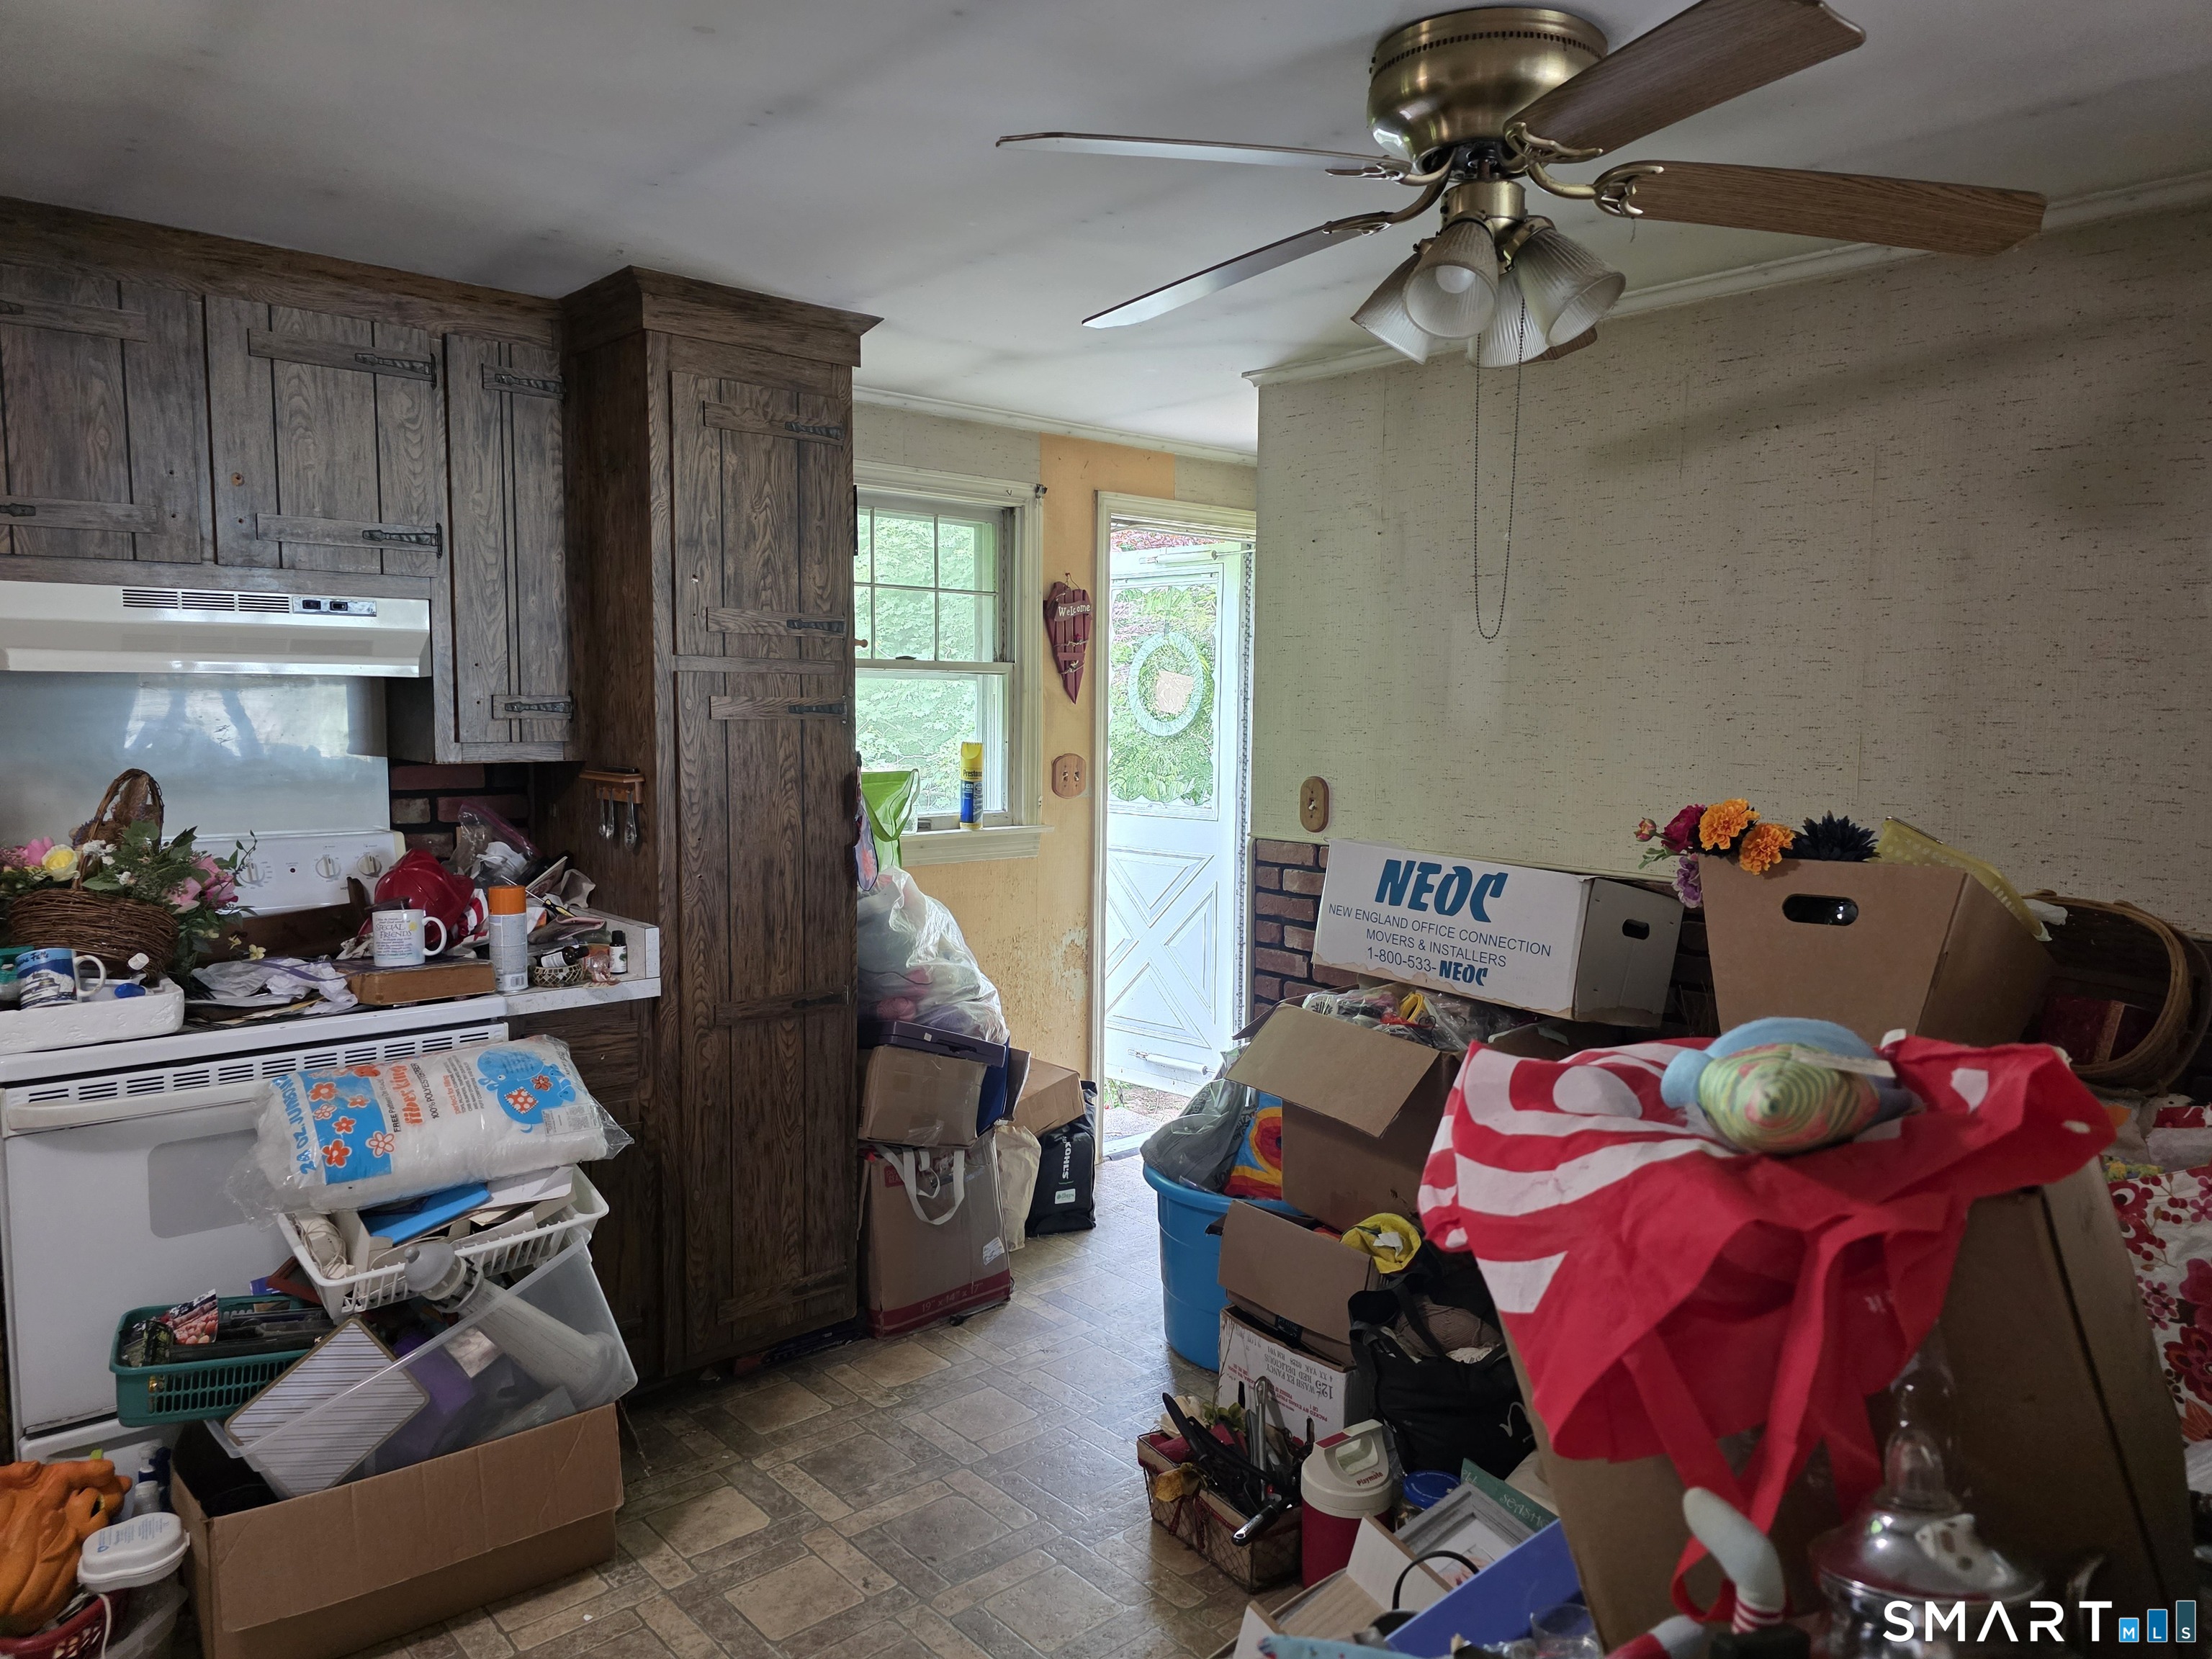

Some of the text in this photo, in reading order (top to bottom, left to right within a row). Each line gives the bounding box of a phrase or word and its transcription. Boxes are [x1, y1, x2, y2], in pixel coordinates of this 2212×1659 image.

[1058, 605, 1091, 617] Welcome
[1374, 859, 1509, 923] NEOC
[380, 930, 413, 939] FRIENDS
[1328, 903, 1552, 957] NEW ENGLAND OFFICE CONNECTION
[1366, 928, 1507, 968] MOVERS & INSTALLERS
[390, 1114, 401, 1133] FREE
[1062, 1141, 1071, 1179] KOHL'S
[1264, 1353, 1296, 1376] DELICIOUS
[1267, 1364, 1286, 1380] FANCY
[1305, 1364, 1317, 1376] YAK
[1287, 1375, 1295, 1385] EX
[1298, 1372, 1312, 1383] RED
[1297, 1379, 1315, 1394] WASH
[1315, 1380, 1334, 1400] 125
[1309, 1410, 1328, 1422] PACKED
[1357, 1471, 1384, 1486] Playmate
